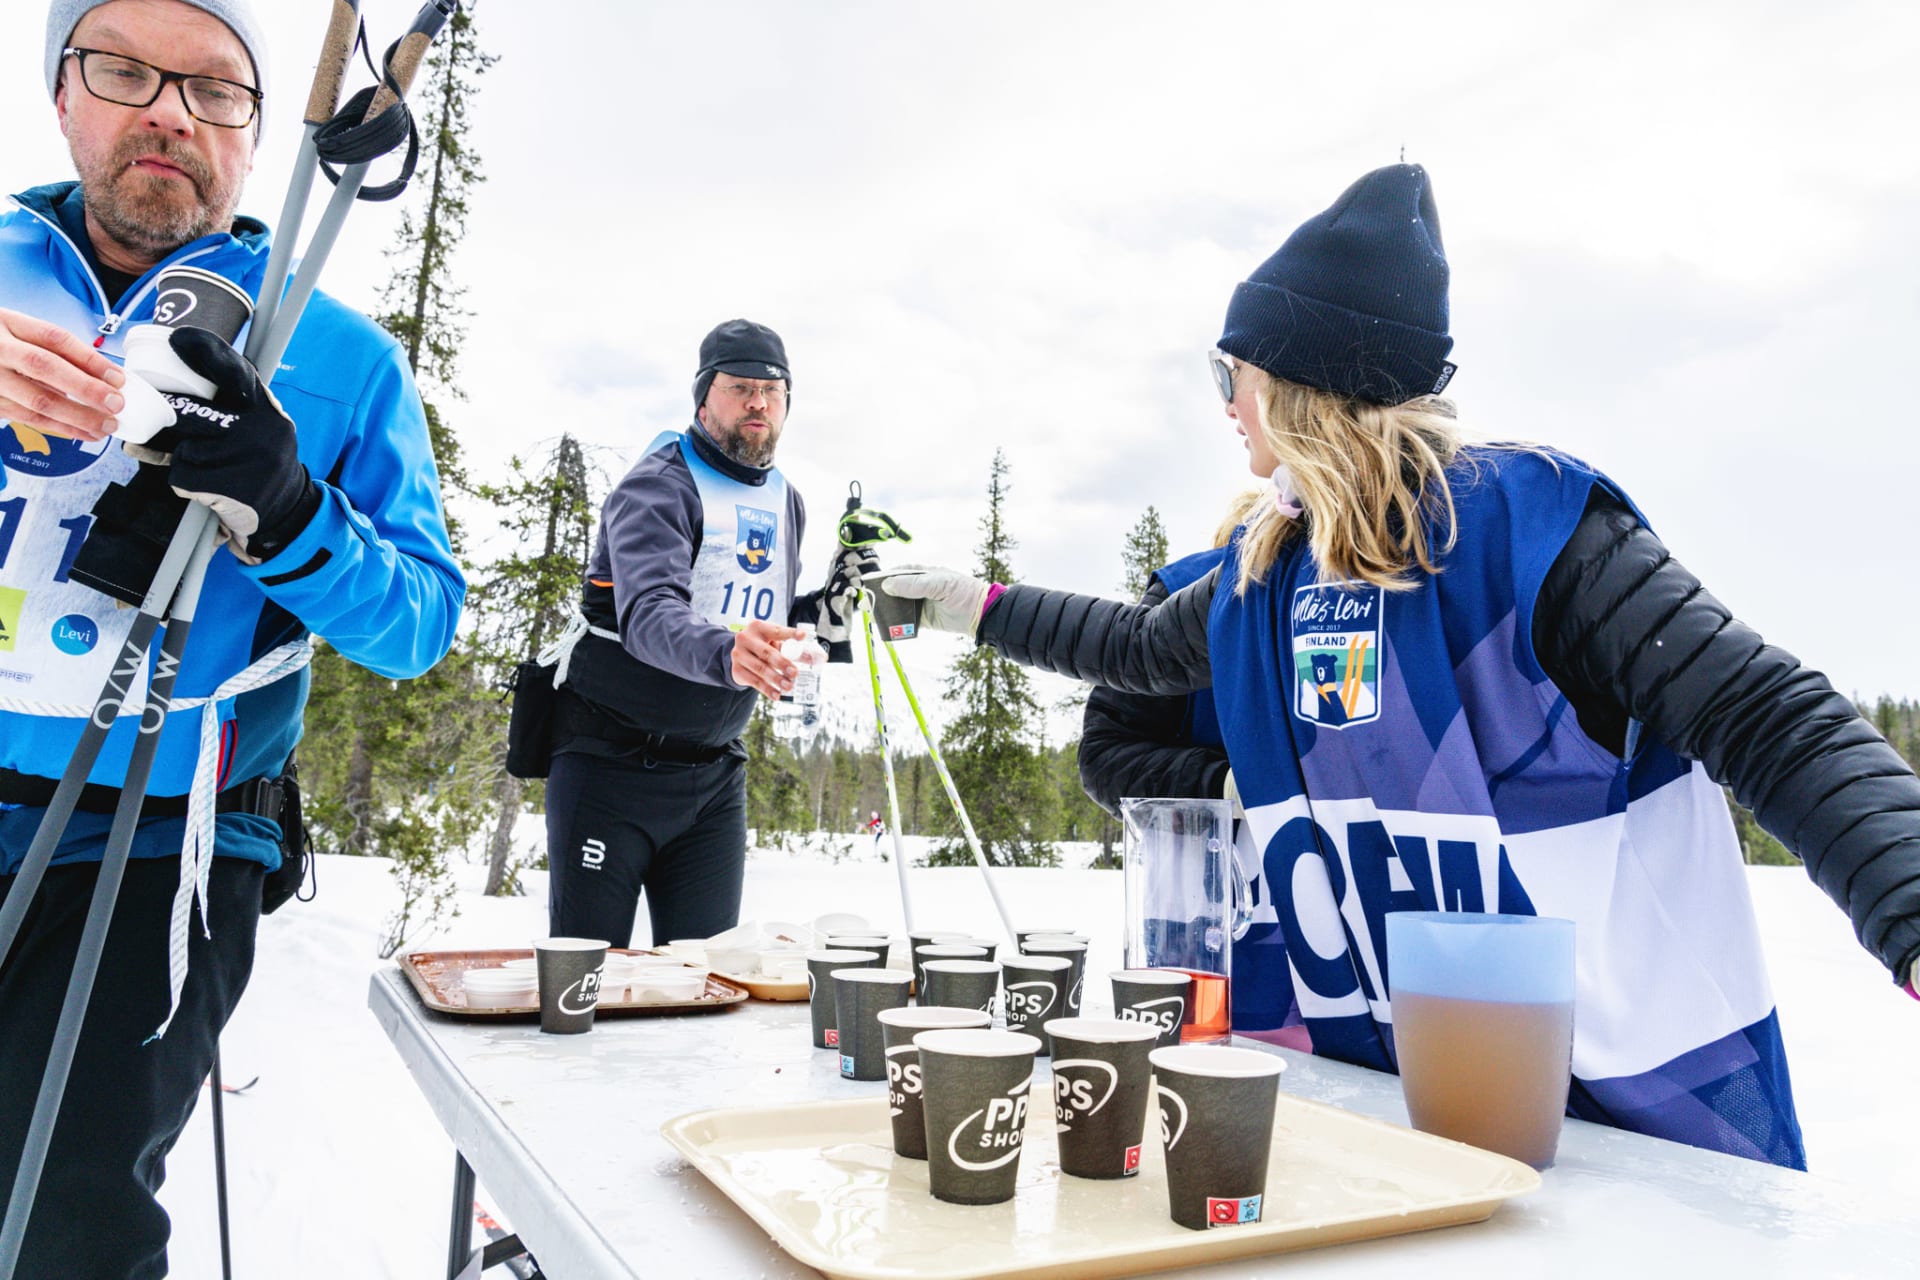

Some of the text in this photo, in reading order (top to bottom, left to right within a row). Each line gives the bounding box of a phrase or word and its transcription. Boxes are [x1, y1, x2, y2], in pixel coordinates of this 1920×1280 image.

[9, 452, 51, 469] SINCE 2017
[720, 581, 774, 621] 110
[59, 625, 92, 643] Levi
[1306, 636, 1347, 647] FINLAND
